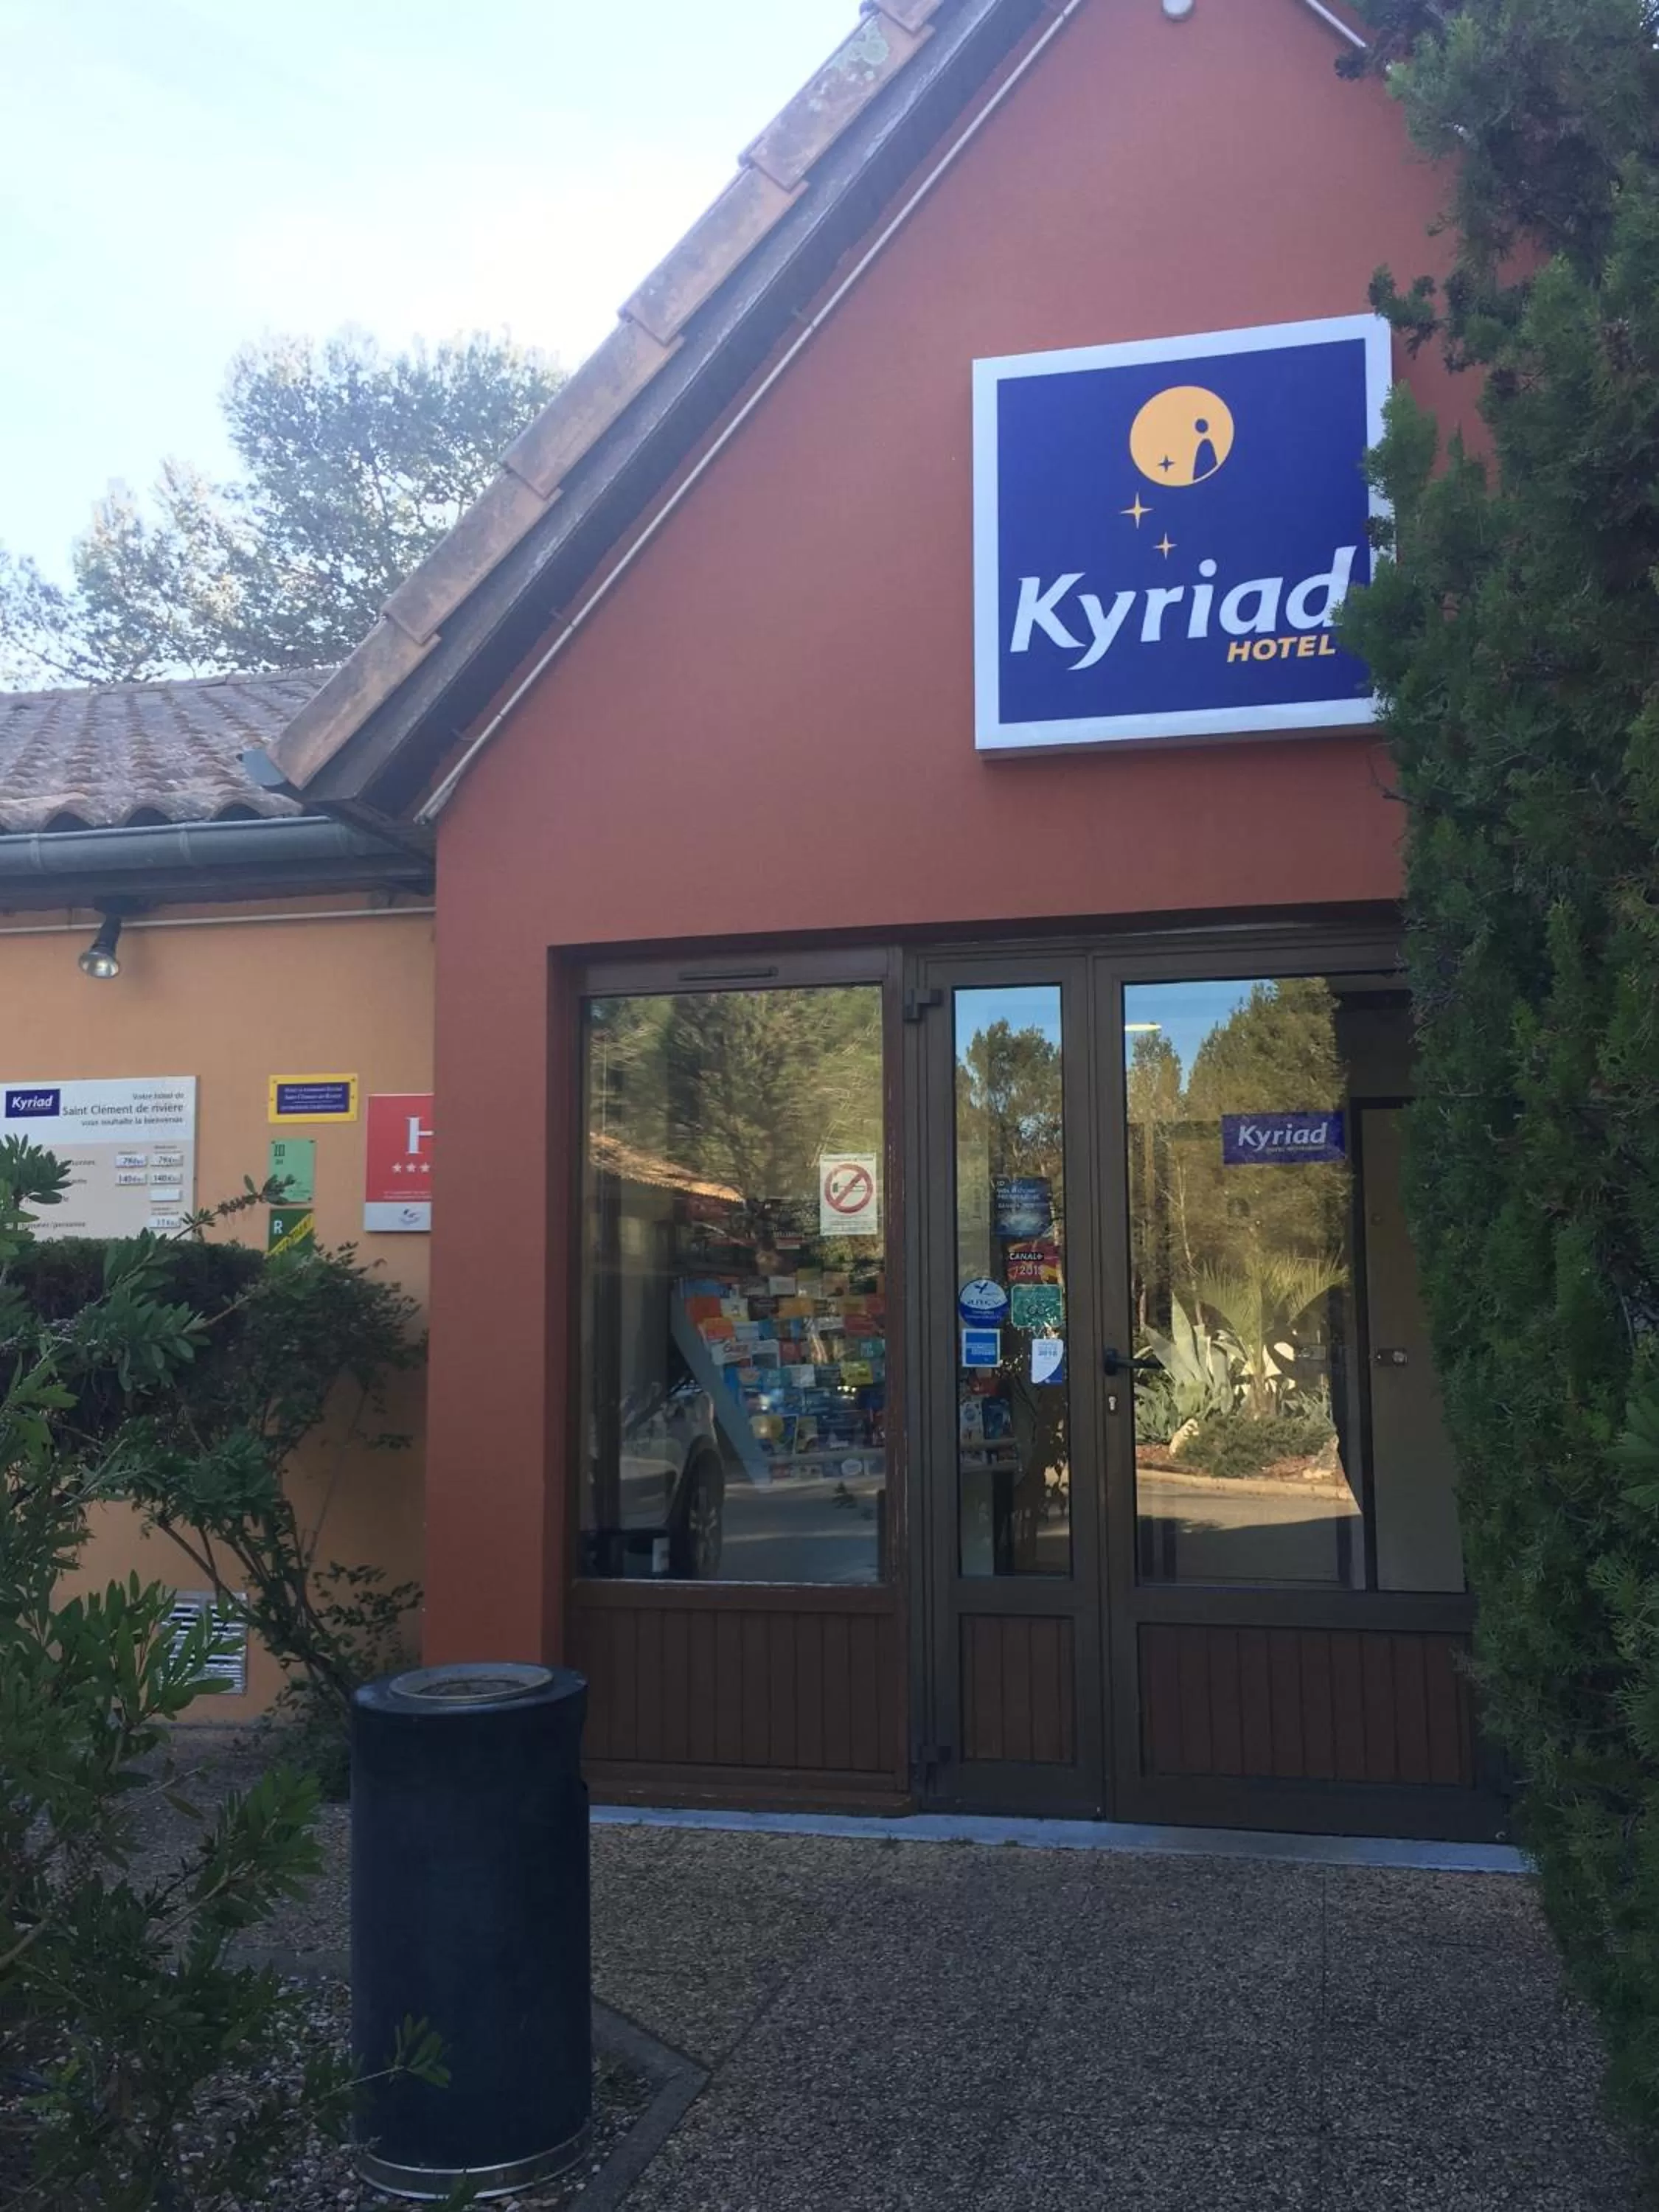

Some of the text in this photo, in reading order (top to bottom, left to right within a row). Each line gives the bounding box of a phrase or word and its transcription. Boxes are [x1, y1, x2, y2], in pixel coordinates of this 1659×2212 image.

[1010, 546, 1357, 670] Kyriad
[1226, 634, 1336, 663] HOTEL
[11, 1095, 54, 1110] Kyriad
[63, 1105, 88, 1116] Saint
[136, 1103, 149, 1113] de
[1238, 1121, 1327, 1151] Kyriad
[274, 1220, 284, 1234] R
